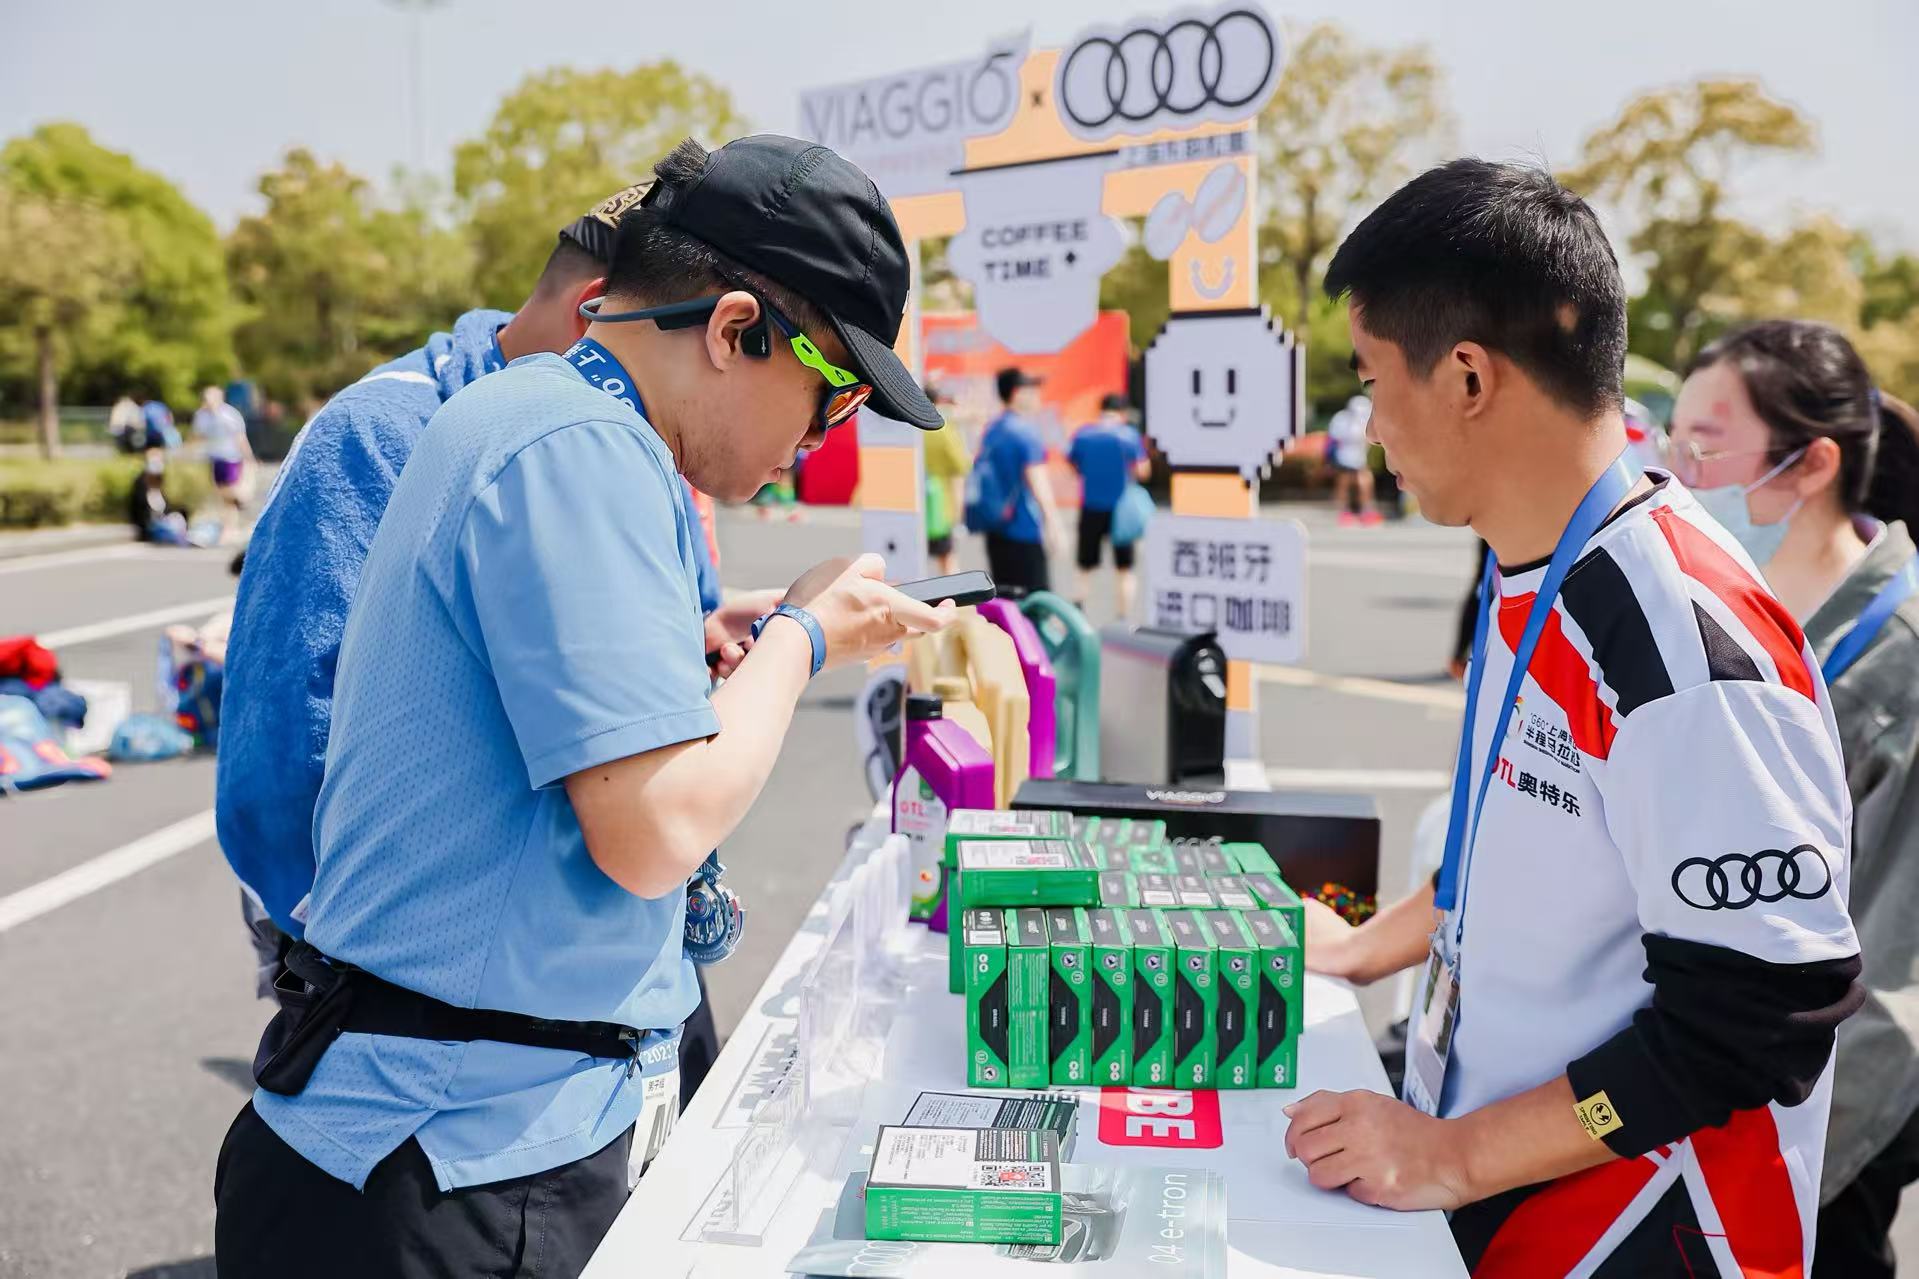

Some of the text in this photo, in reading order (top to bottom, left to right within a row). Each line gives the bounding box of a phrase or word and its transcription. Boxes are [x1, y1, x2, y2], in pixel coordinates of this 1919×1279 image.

[980, 218, 1088, 249] COFFEE
[984, 256, 1050, 281] TIME
[1525, 724, 1581, 767] 半程马拉松
[1157, 1173, 1188, 1240] e-tron
